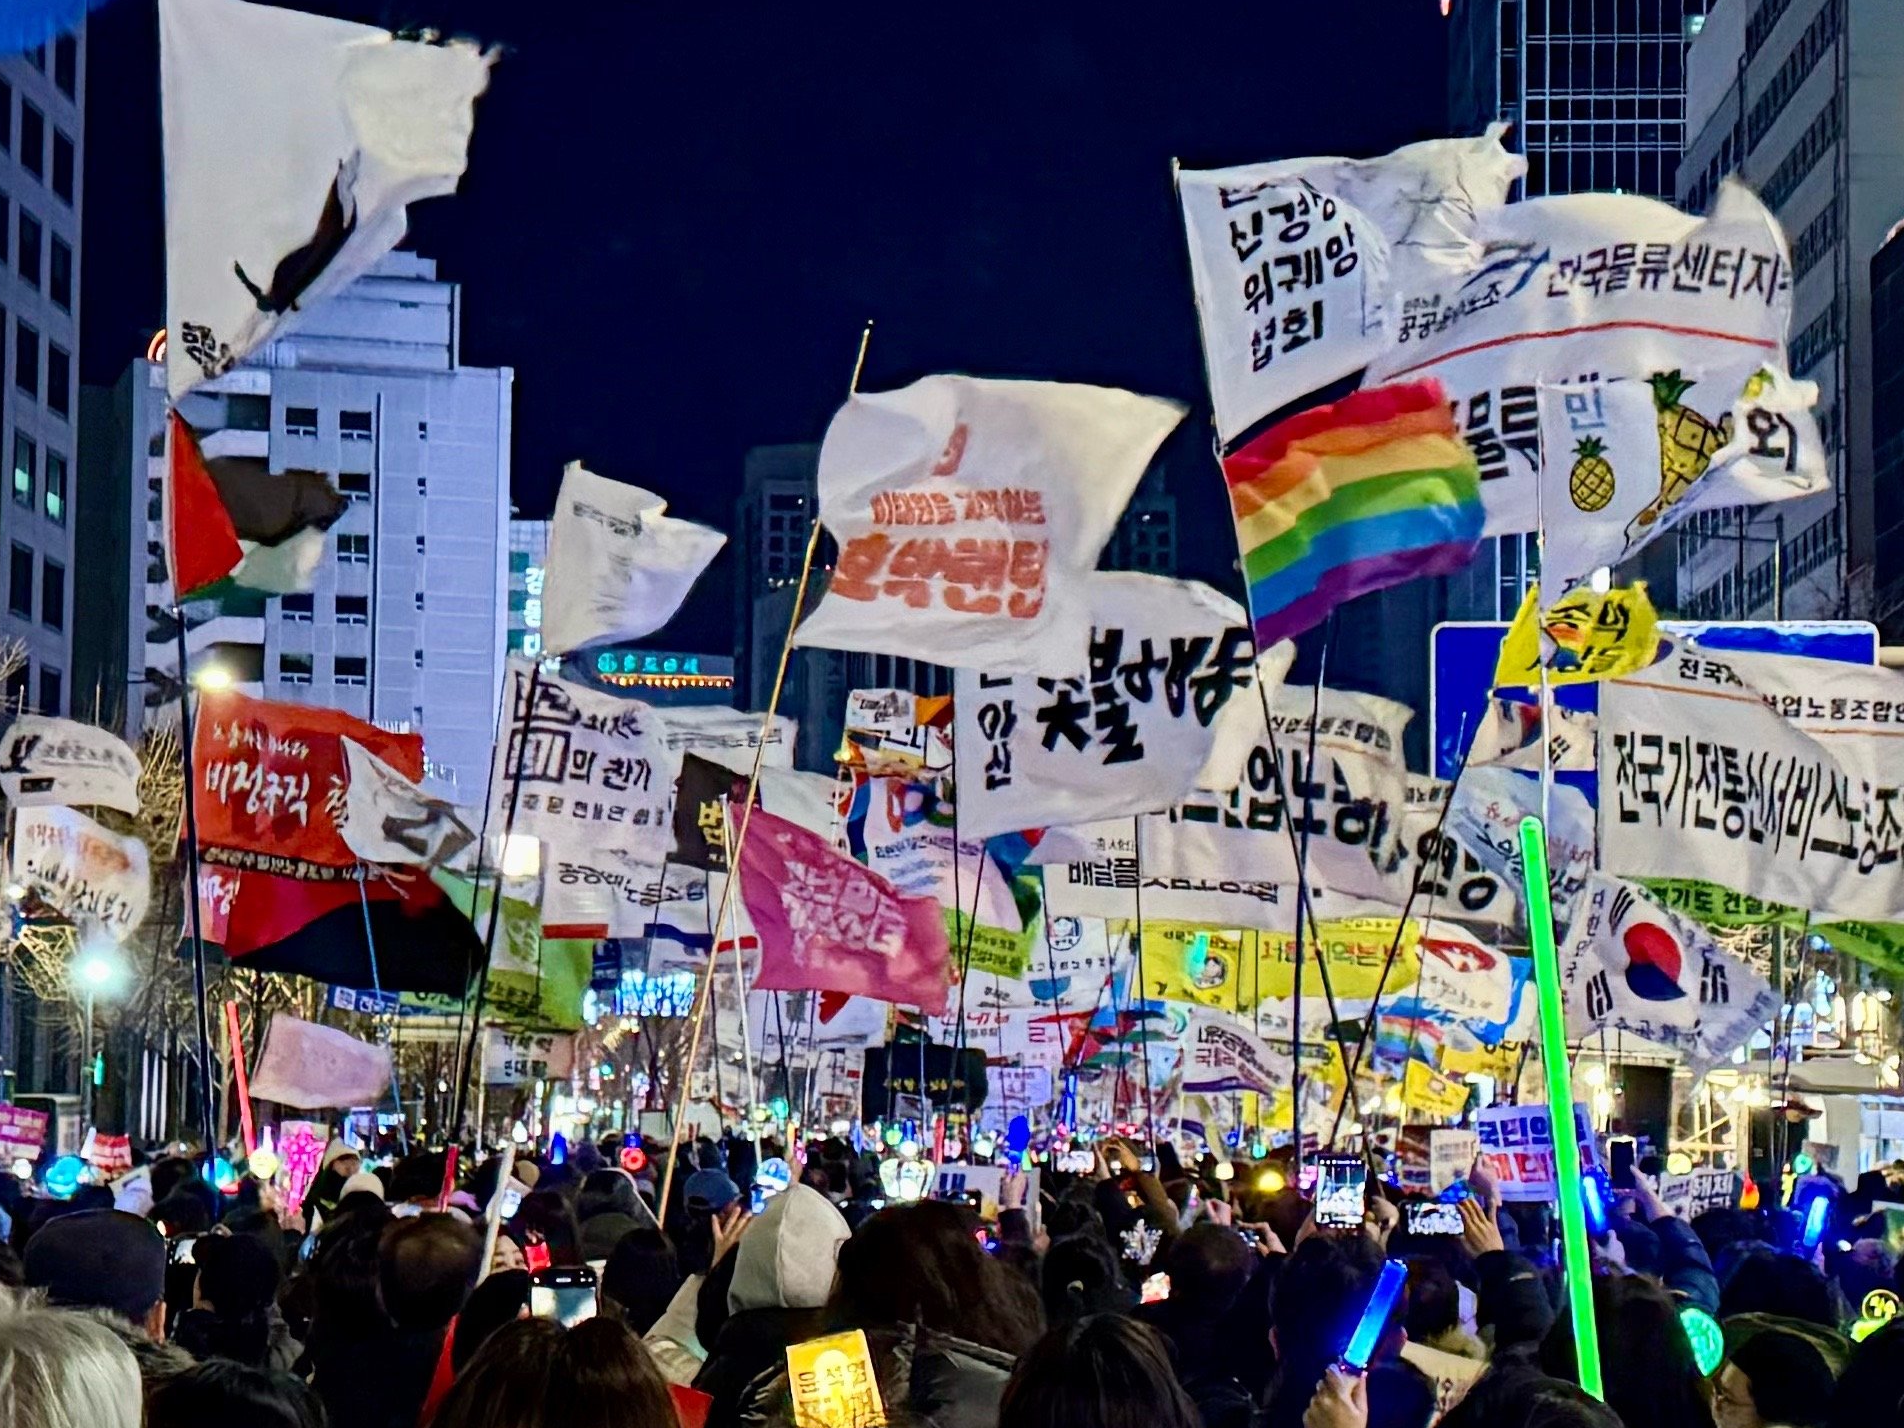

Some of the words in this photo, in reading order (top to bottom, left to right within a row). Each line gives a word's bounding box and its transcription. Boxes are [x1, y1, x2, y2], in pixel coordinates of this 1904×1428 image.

[1244, 222, 1359, 314] 위궤양
[1251, 299, 1324, 373] 협회
[206, 759, 311, 829] 비정규직
